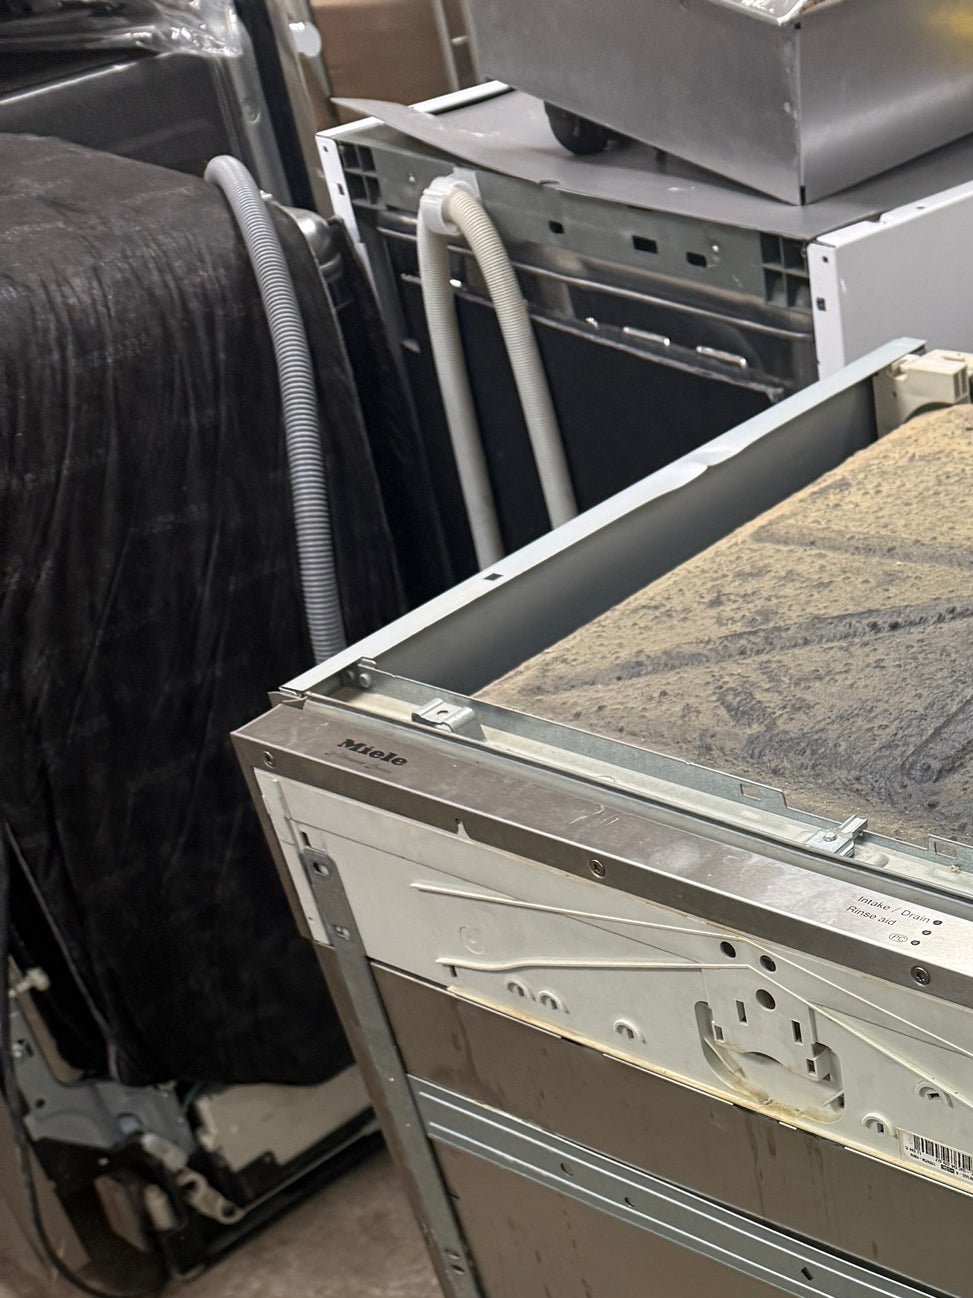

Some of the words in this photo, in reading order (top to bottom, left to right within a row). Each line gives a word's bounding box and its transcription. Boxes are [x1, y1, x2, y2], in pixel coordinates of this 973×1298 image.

[337, 738, 408, 766] Miele
[846, 905, 877, 921] Rinse
[877, 916, 897, 927] aid
[857, 895, 891, 912] Intake
[900, 909, 931, 925] Drain
